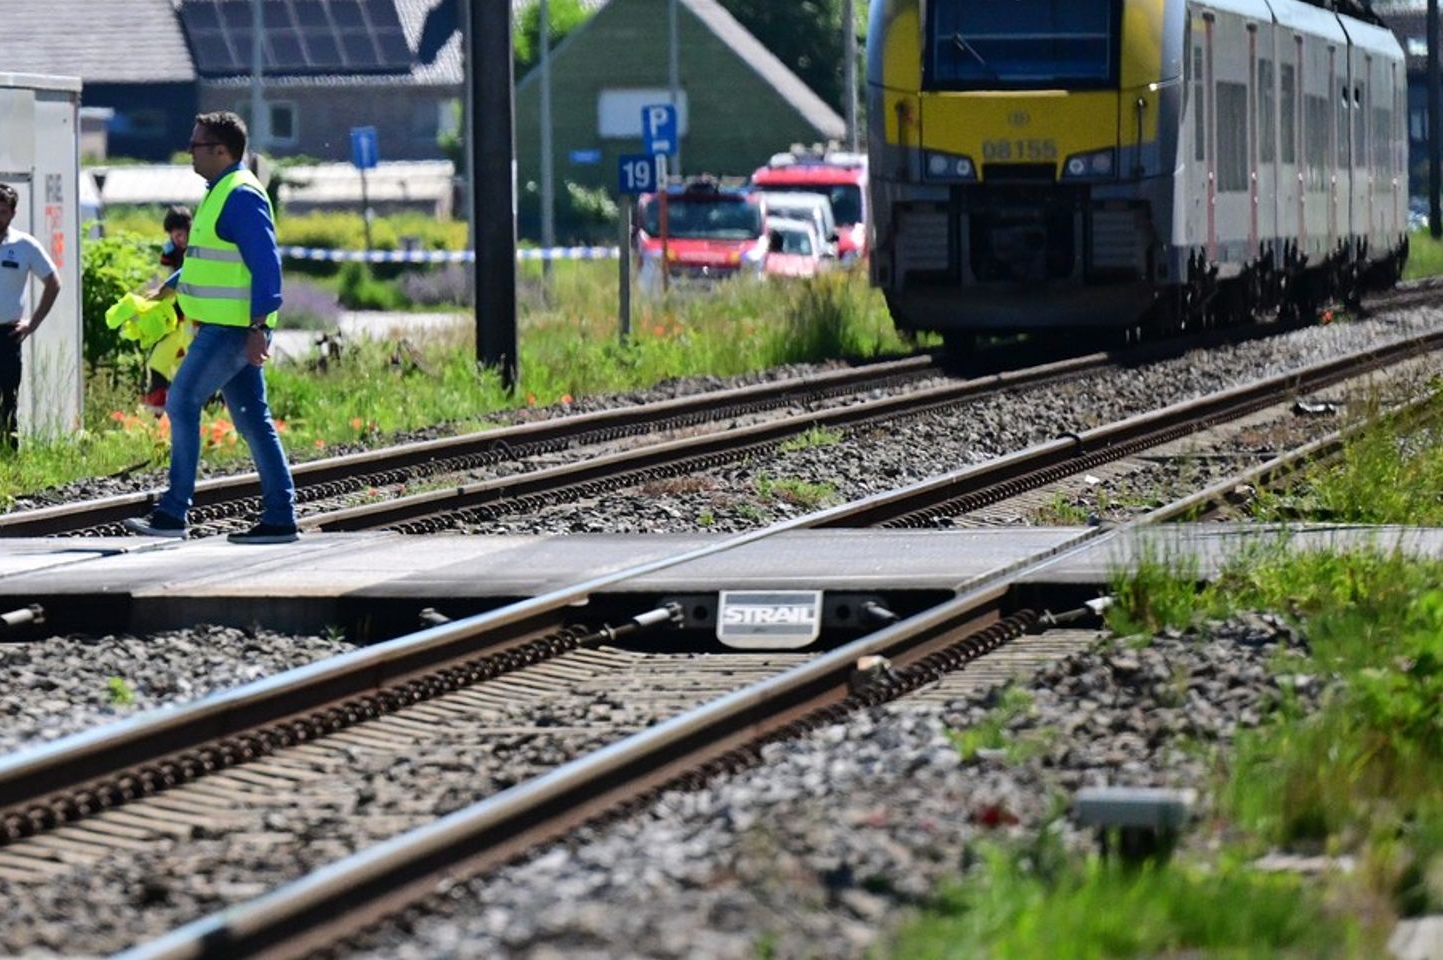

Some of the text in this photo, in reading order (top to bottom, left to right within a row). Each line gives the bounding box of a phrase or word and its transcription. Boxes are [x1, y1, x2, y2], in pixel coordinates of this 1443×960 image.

[650, 107, 668, 137] P
[623, 160, 650, 189] 19
[723, 606, 814, 624] STRAIL
